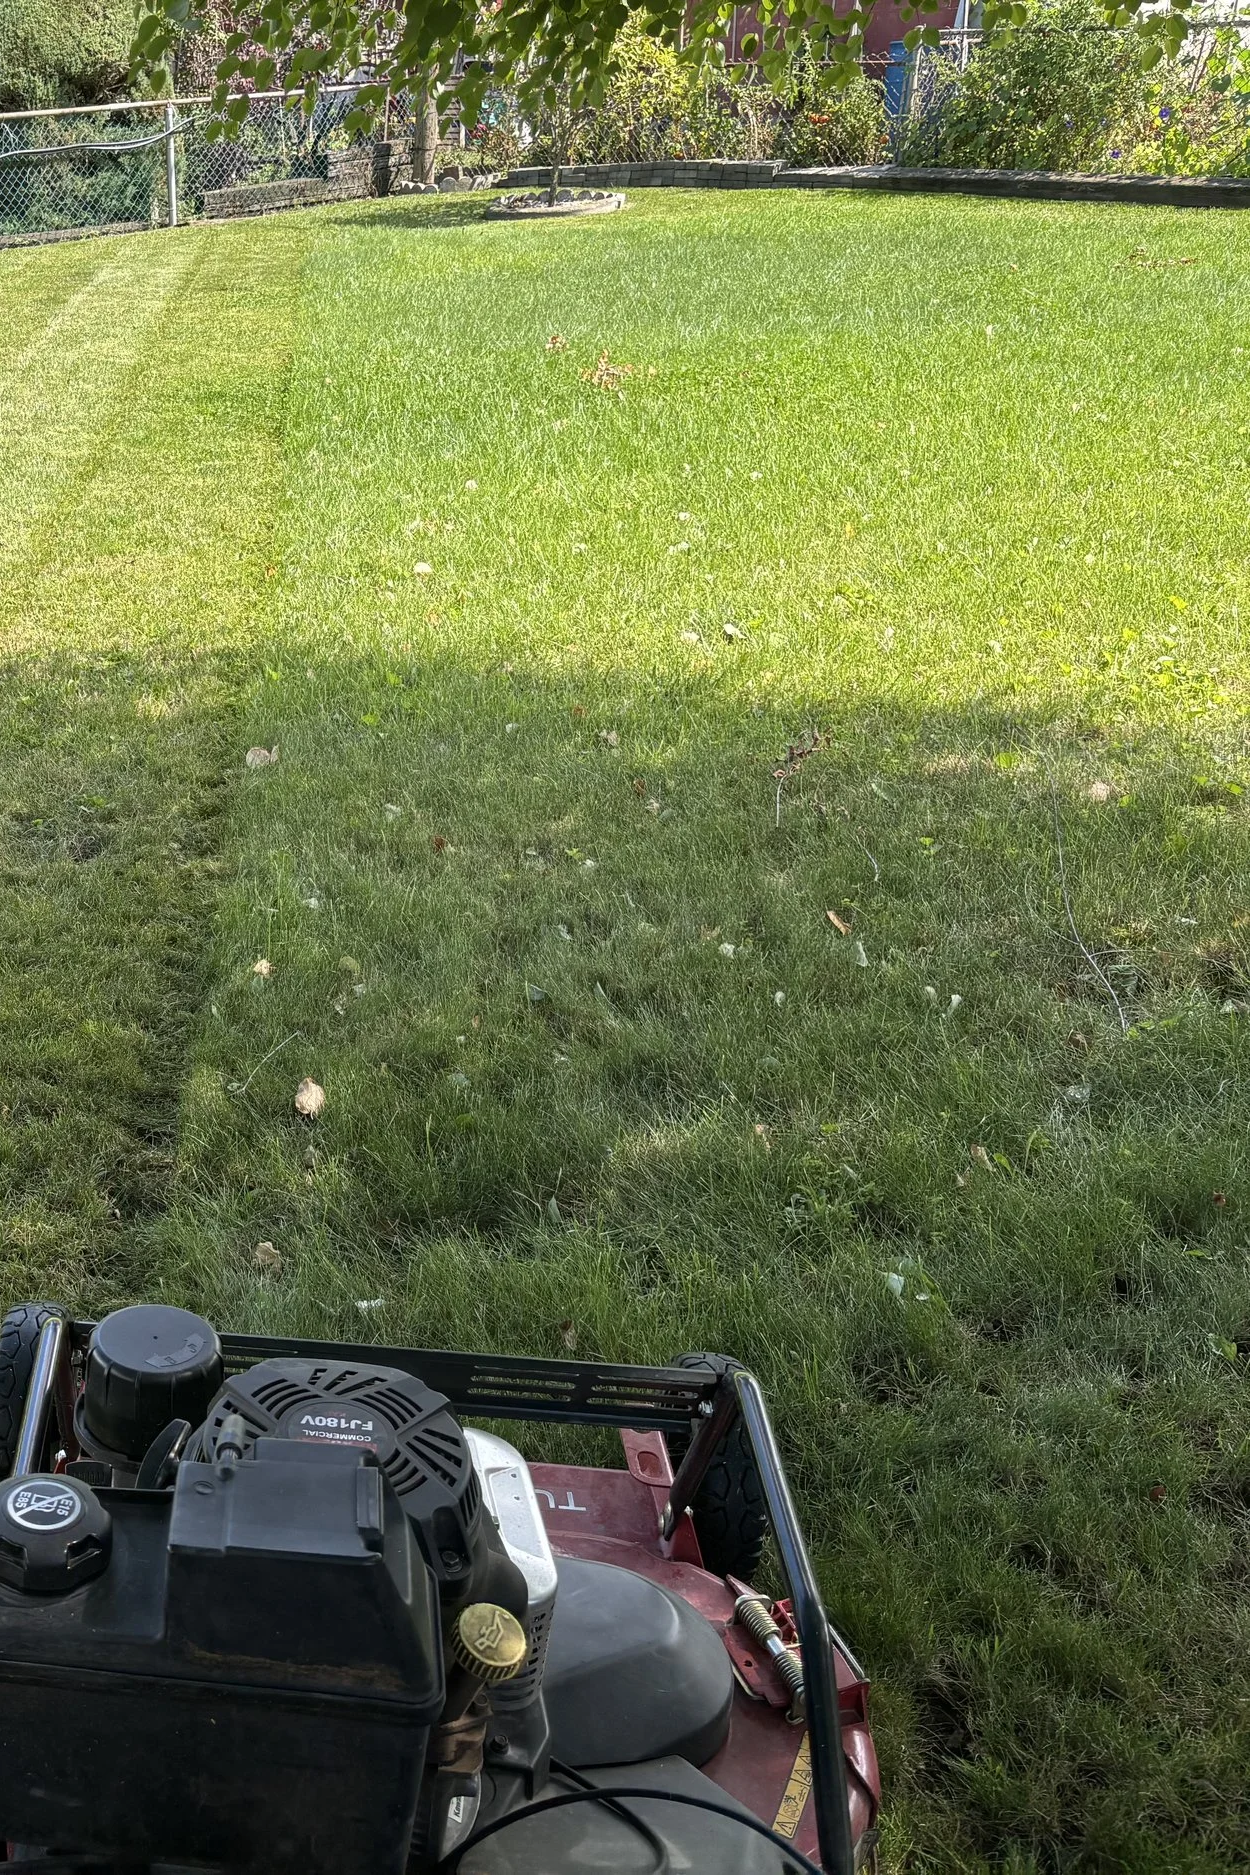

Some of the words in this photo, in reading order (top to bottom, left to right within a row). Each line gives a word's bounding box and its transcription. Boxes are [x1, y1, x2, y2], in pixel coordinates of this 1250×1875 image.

[300, 1415, 373, 1431] FJ180V
[302, 1429, 371, 1442] COMMERCIAL
[15, 1491, 32, 1508] E85
[57, 1499, 73, 1516] E15
[534, 1489, 587, 1511] TU
